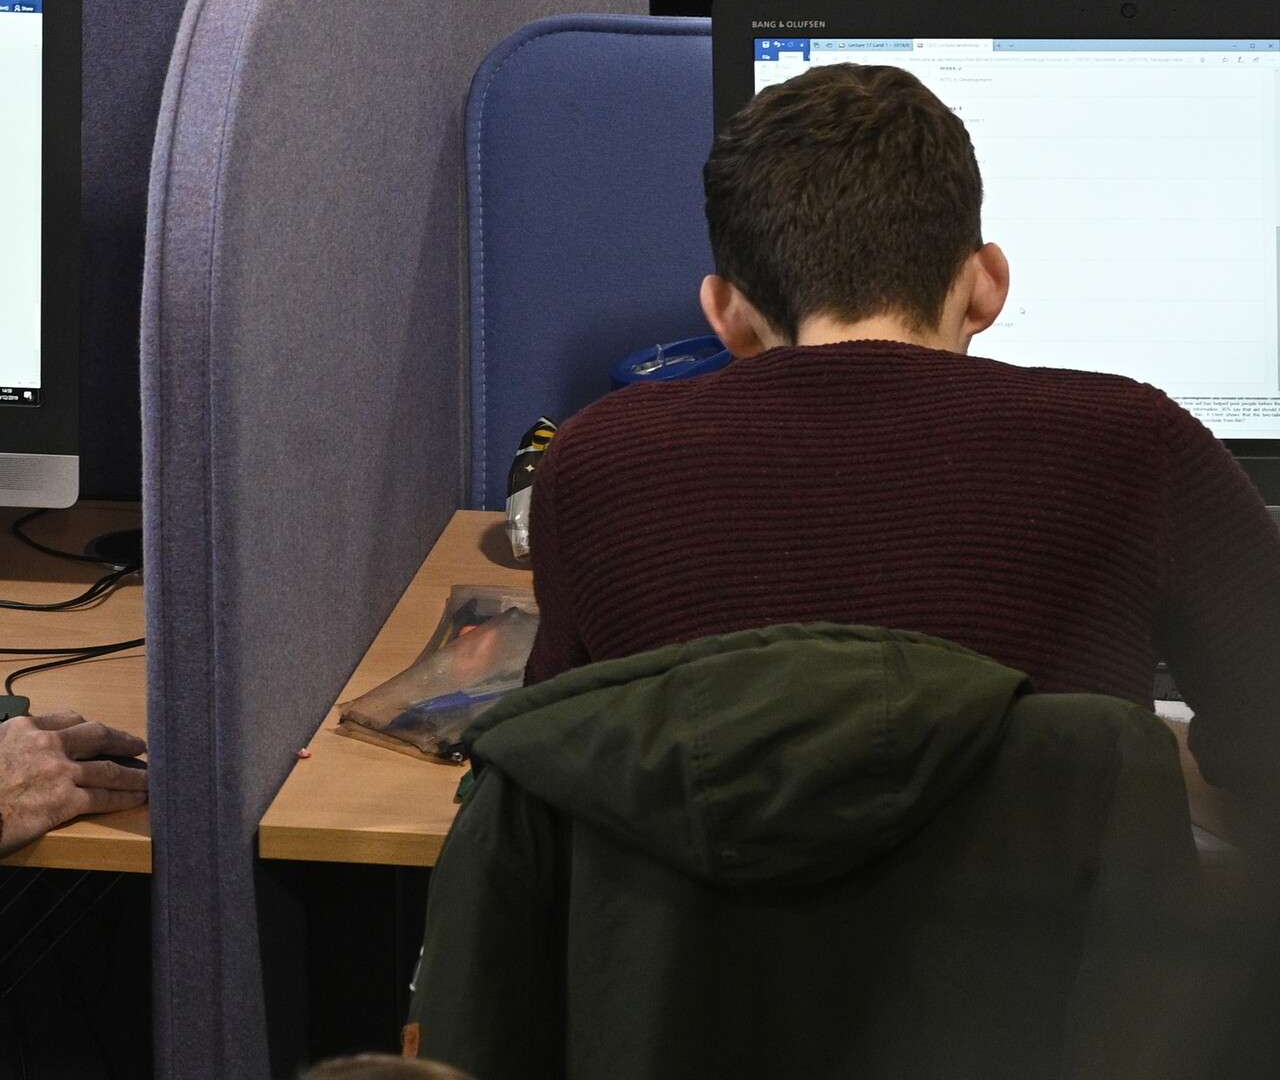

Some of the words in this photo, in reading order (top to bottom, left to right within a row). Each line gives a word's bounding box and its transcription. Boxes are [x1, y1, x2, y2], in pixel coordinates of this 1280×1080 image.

[751, 20, 776, 28] BANG
[778, 20, 785, 28] &
[786, 20, 826, 29] OLUFSEN
